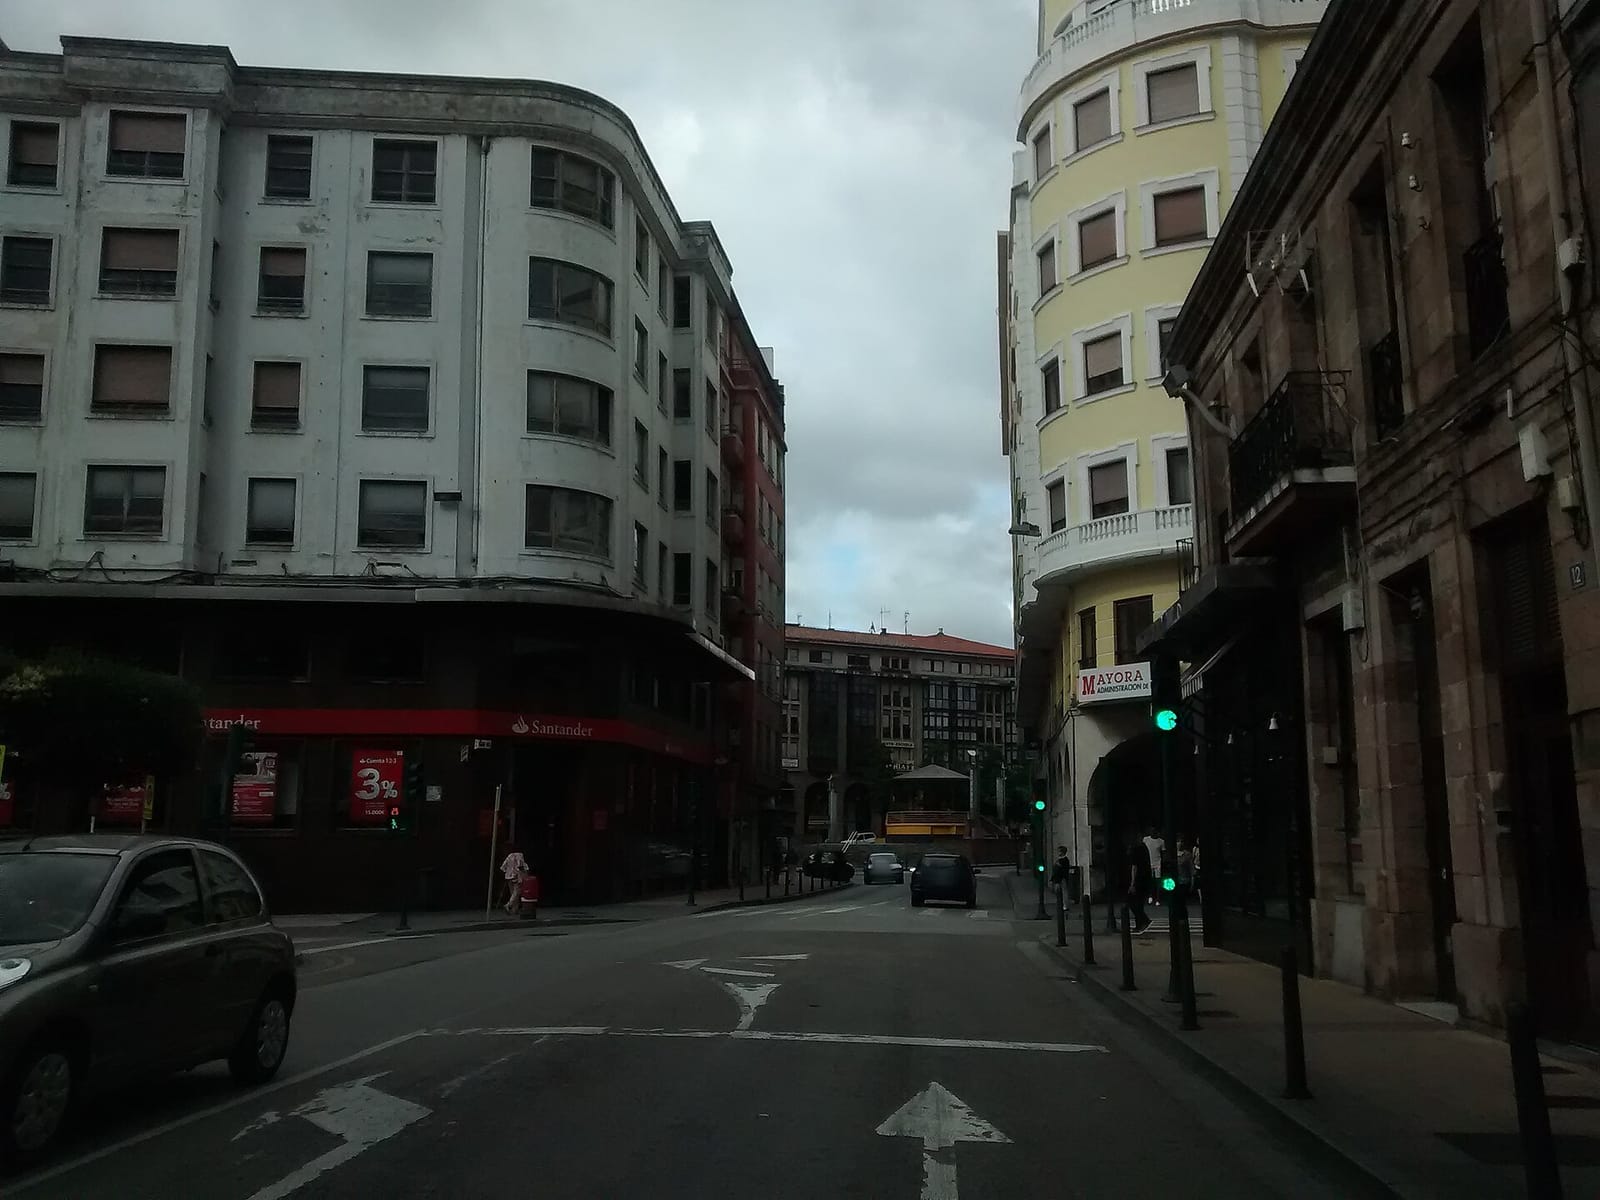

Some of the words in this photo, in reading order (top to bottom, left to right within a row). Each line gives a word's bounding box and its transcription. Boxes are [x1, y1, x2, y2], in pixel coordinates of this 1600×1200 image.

[1571, 566, 1582, 583] 12
[1082, 670, 1144, 695] MAYORA
[531, 719, 593, 737] Santander
[354, 767, 399, 800] 3%
